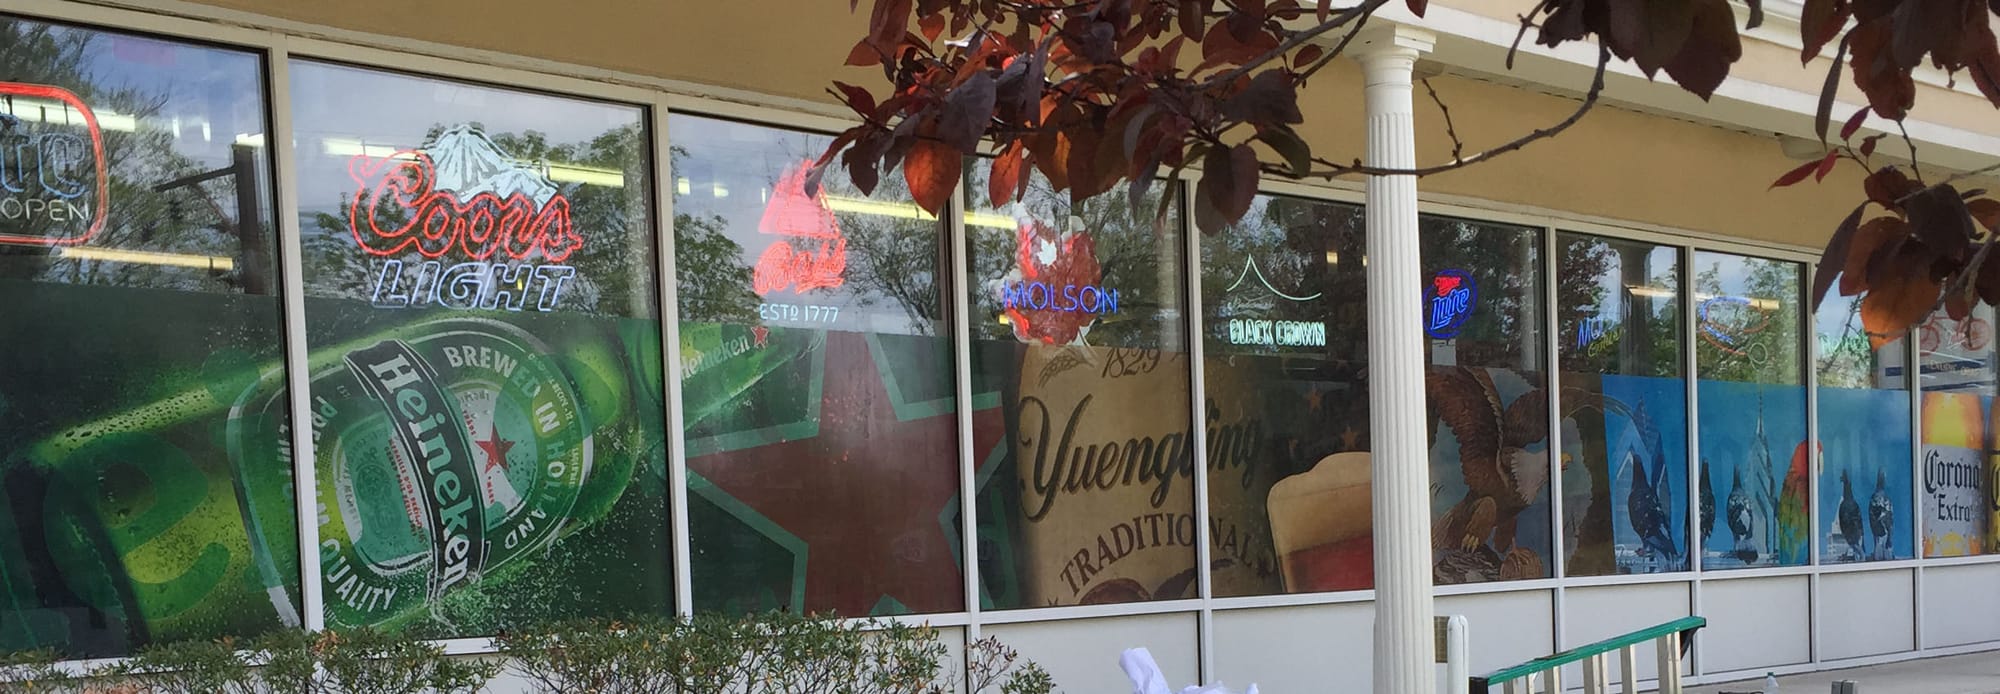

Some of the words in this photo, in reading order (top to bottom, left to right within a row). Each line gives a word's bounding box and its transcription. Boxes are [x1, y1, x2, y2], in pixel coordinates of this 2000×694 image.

[1, 198, 90, 221] OPEN
[349, 150, 584, 263] Coors
[372, 259, 576, 313] LIGHT
[1003, 279, 1119, 314] MOLSON
[804, 304, 839, 323] 1777
[1430, 287, 1470, 331] Lite
[1229, 318, 1274, 345] BLACK
[1275, 320, 1326, 347] CROWN
[443, 344, 541, 399] BREWED
[535, 401, 561, 434] IN
[368, 353, 474, 588] Heineken
[1924, 449, 1983, 494] Corona
[1938, 494, 1972, 522] Extra
[319, 538, 398, 613] QUALITY
[1059, 510, 1256, 597] TRADITIONAL
